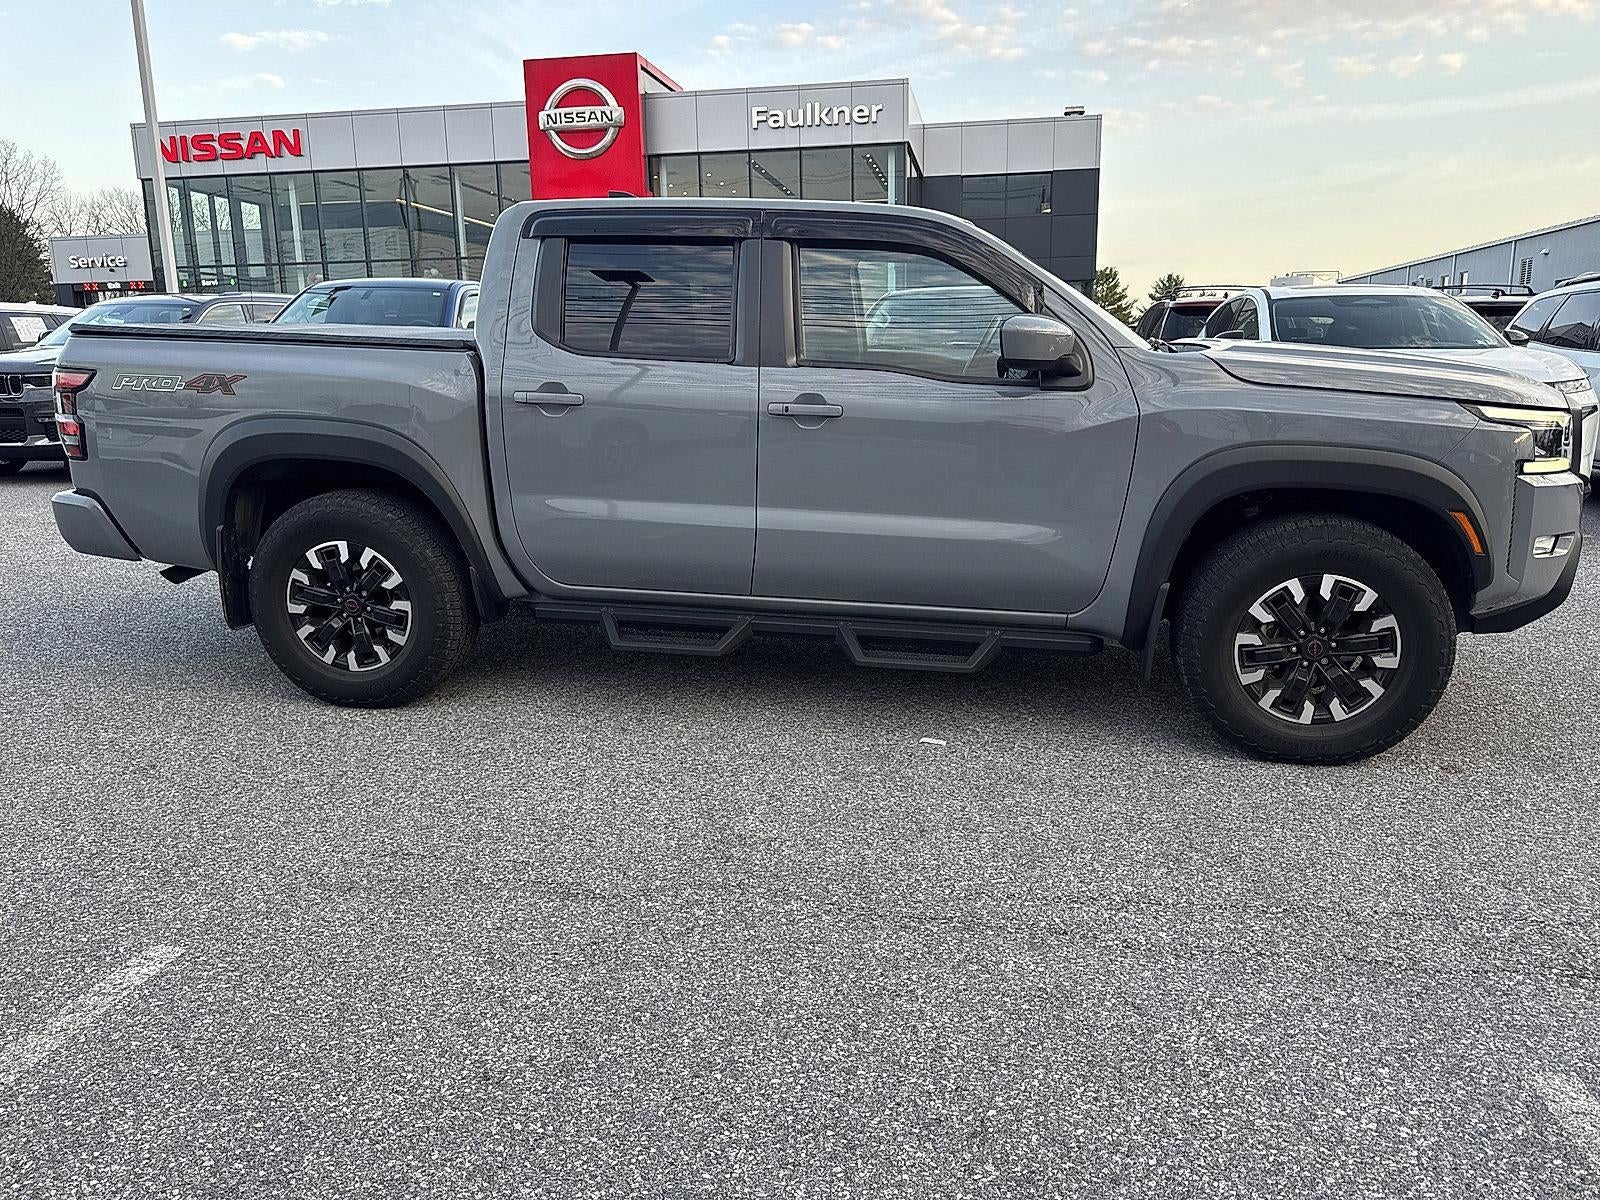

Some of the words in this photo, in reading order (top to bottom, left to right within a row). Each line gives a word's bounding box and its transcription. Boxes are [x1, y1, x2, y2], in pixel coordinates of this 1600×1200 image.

[546, 110, 614, 126] NISSAN
[751, 101, 883, 130] Faulkner
[160, 128, 302, 163] NISSAN
[68, 253, 126, 269] Service
